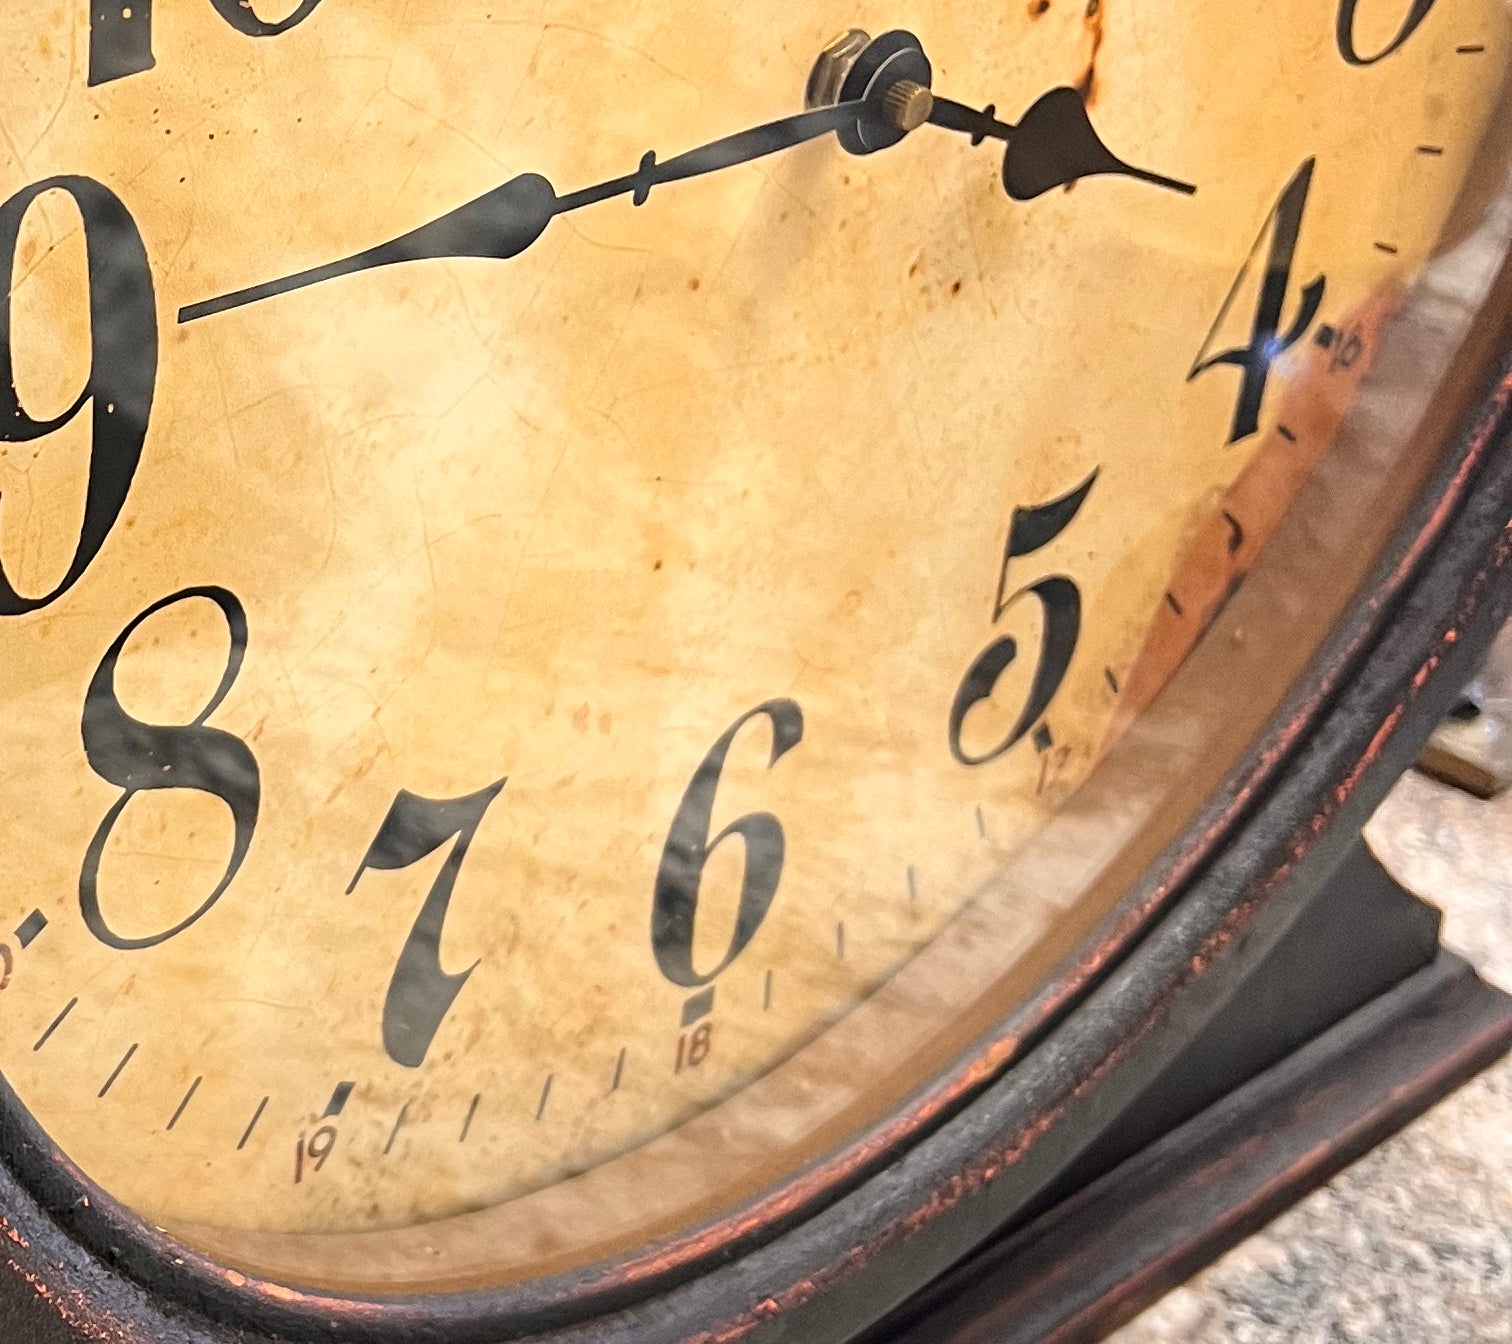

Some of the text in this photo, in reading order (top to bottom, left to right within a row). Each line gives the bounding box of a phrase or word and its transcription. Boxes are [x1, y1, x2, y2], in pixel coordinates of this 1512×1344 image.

[1184, 156, 1327, 446] 4
[949, 465, 1099, 765] 5
[76, 584, 262, 951] 8
[650, 697, 805, 988] 6
[344, 776, 507, 1068] 7
[674, 1022, 713, 1075] 18
[293, 1125, 338, 1184] 19
